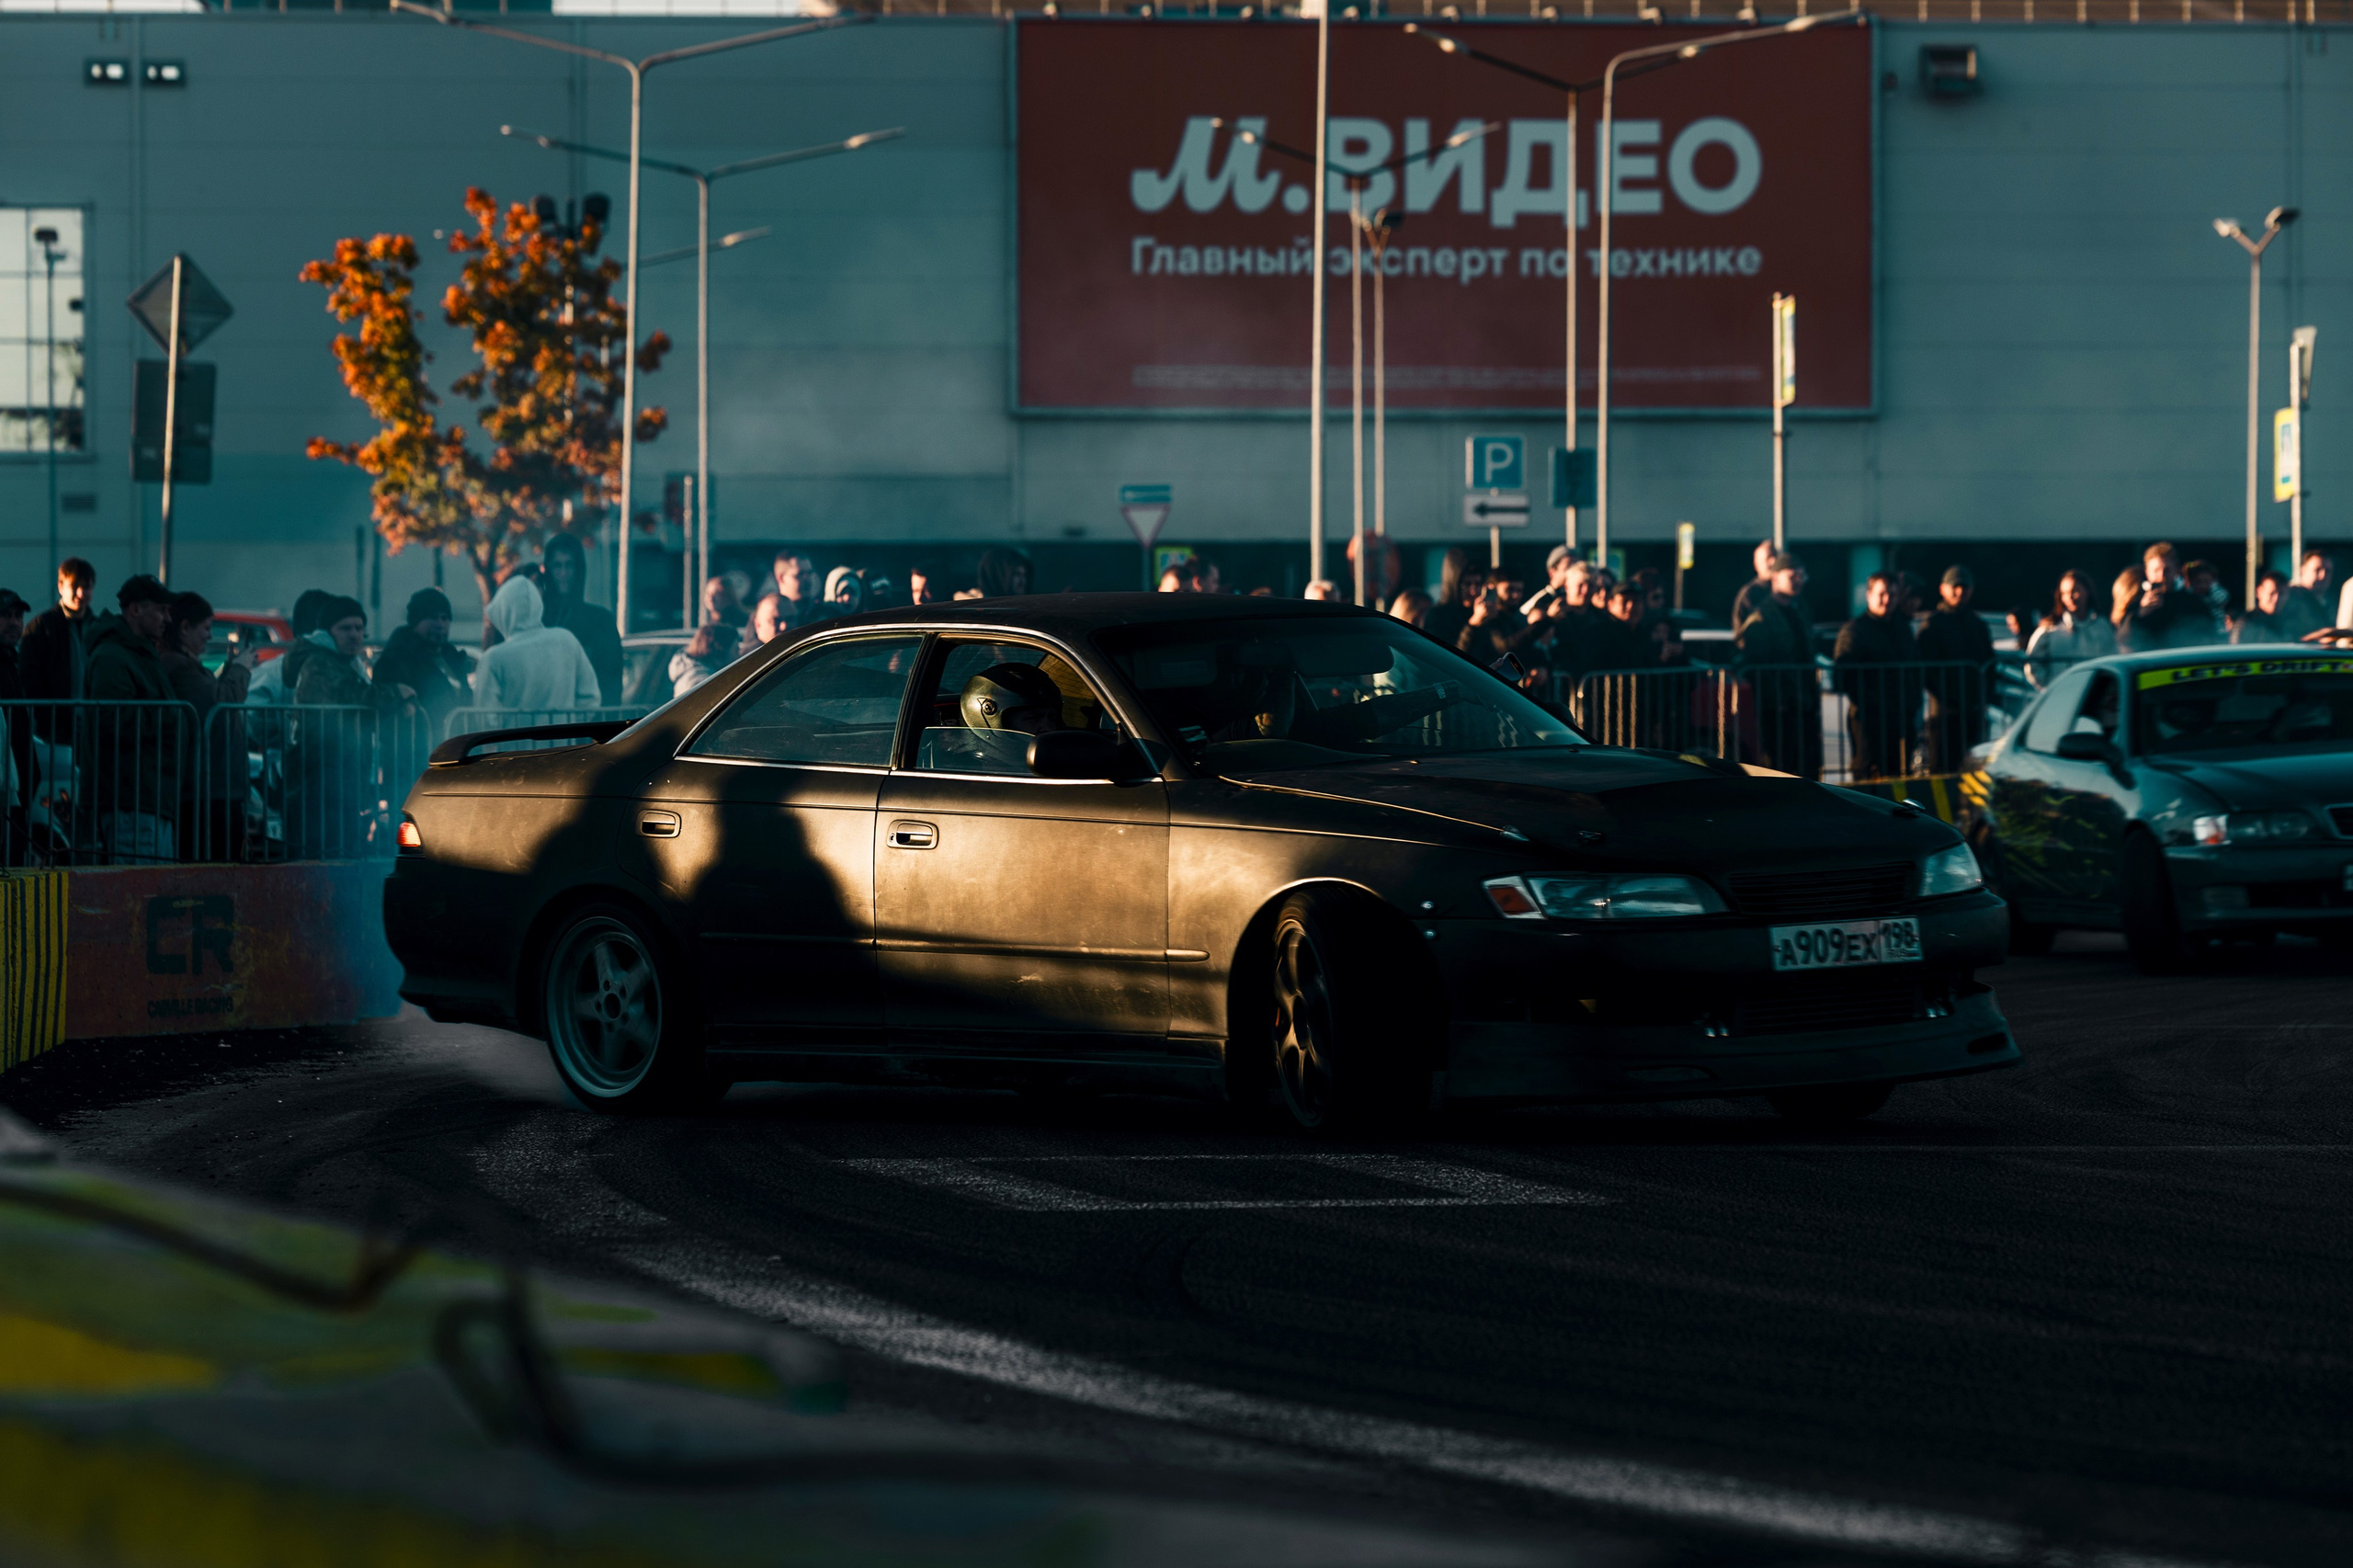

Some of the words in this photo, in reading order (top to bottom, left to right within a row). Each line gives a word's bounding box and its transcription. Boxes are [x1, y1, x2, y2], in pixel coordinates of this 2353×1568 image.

[1130, 116, 1763, 229] М.ВИДЕО
[1131, 235, 1315, 276] Главный
[1328, 245, 1510, 287] эксперт
[1519, 246, 1573, 277] по
[1585, 245, 1763, 278] технике
[1484, 441, 1515, 484] P
